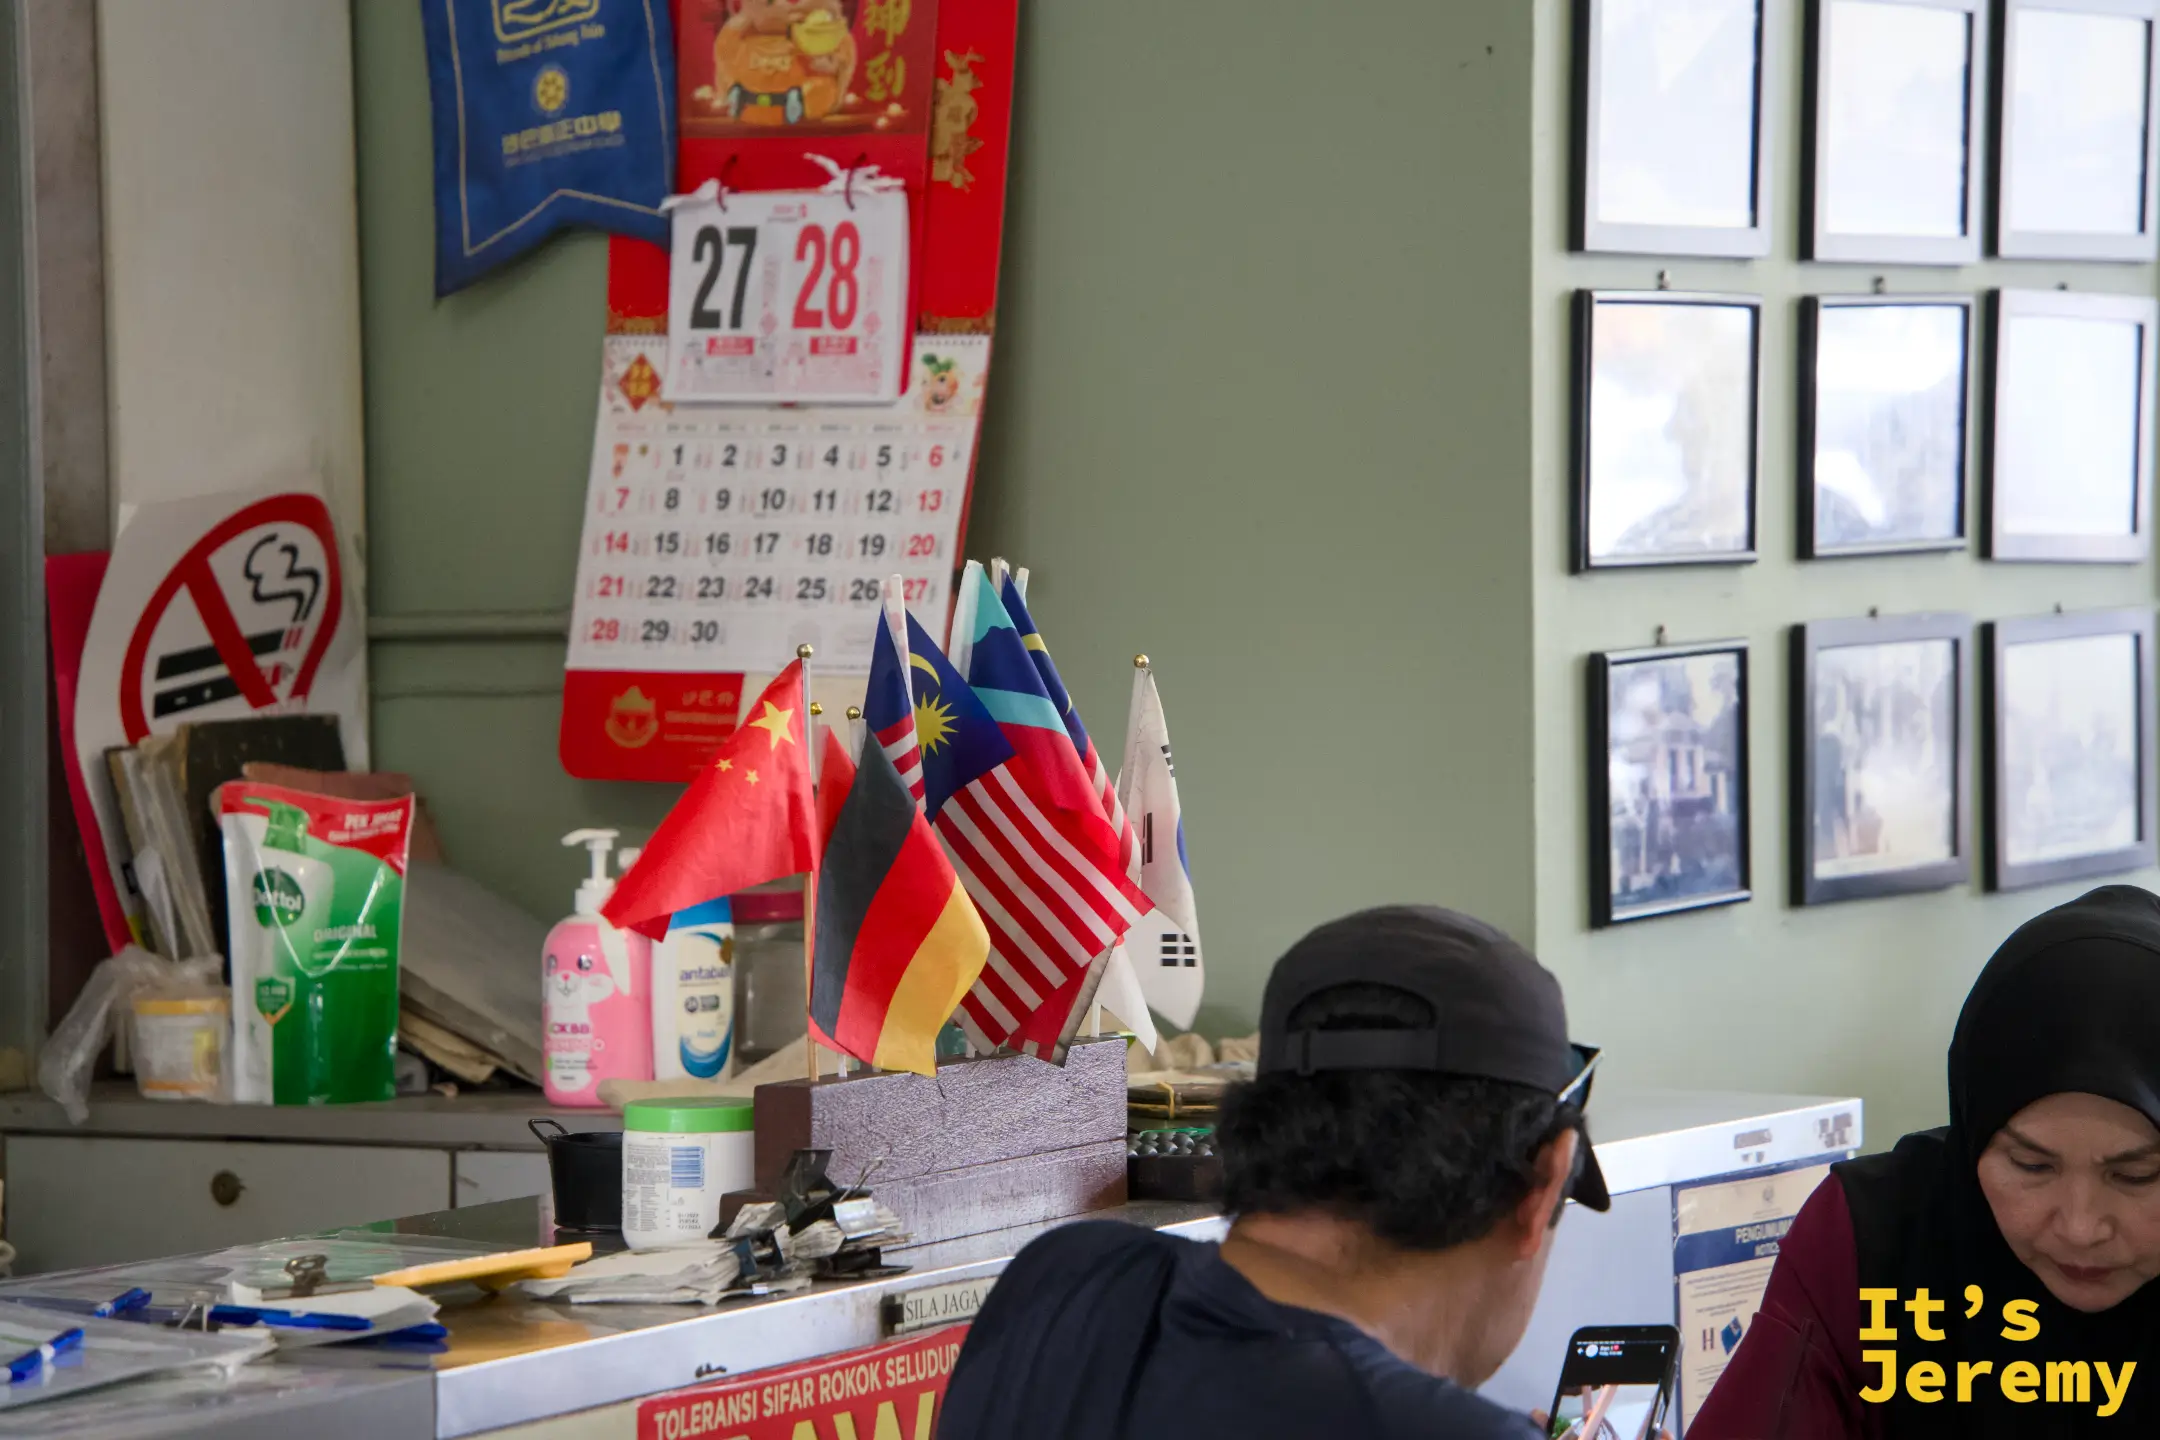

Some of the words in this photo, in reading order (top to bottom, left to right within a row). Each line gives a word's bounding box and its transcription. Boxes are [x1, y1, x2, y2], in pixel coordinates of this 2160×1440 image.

[689, 224, 758, 330] 27
[791, 220, 861, 331] 28
[673, 444, 684, 466] 1
[721, 443, 738, 467] 2
[771, 444, 788, 467] 3
[823, 445, 839, 467] 4
[876, 444, 892, 468] 5
[927, 444, 944, 469] 6
[615, 486, 631, 510] 7
[664, 487, 680, 511] 8
[716, 488, 731, 511] 9
[760, 488, 786, 511] 10
[813, 489, 837, 512] 11
[866, 489, 893, 513] 12
[919, 489, 943, 512] 13
[605, 531, 629, 553] 14
[655, 531, 680, 555] 15
[705, 532, 731, 555] 16
[754, 532, 781, 554] 17
[806, 533, 833, 556] 18
[859, 533, 886, 557] 19
[907, 533, 936, 558] 20
[597, 574, 625, 598] 21
[645, 575, 676, 599] 22
[697, 576, 726, 599] 23
[744, 576, 773, 599] 24
[796, 577, 827, 600] 25
[849, 578, 879, 602] 26
[591, 619, 620, 642] 28
[641, 619, 671, 643] 29
[690, 620, 719, 643] 30
[313, 924, 378, 943] ORIGINAL
[905, 1296, 939, 1322] SILA
[942, 1287, 981, 1315] JAGA
[653, 1390, 758, 1440] TOLERANSI
[761, 1376, 815, 1417] SIFAR
[818, 1362, 881, 1402] ROKOK
